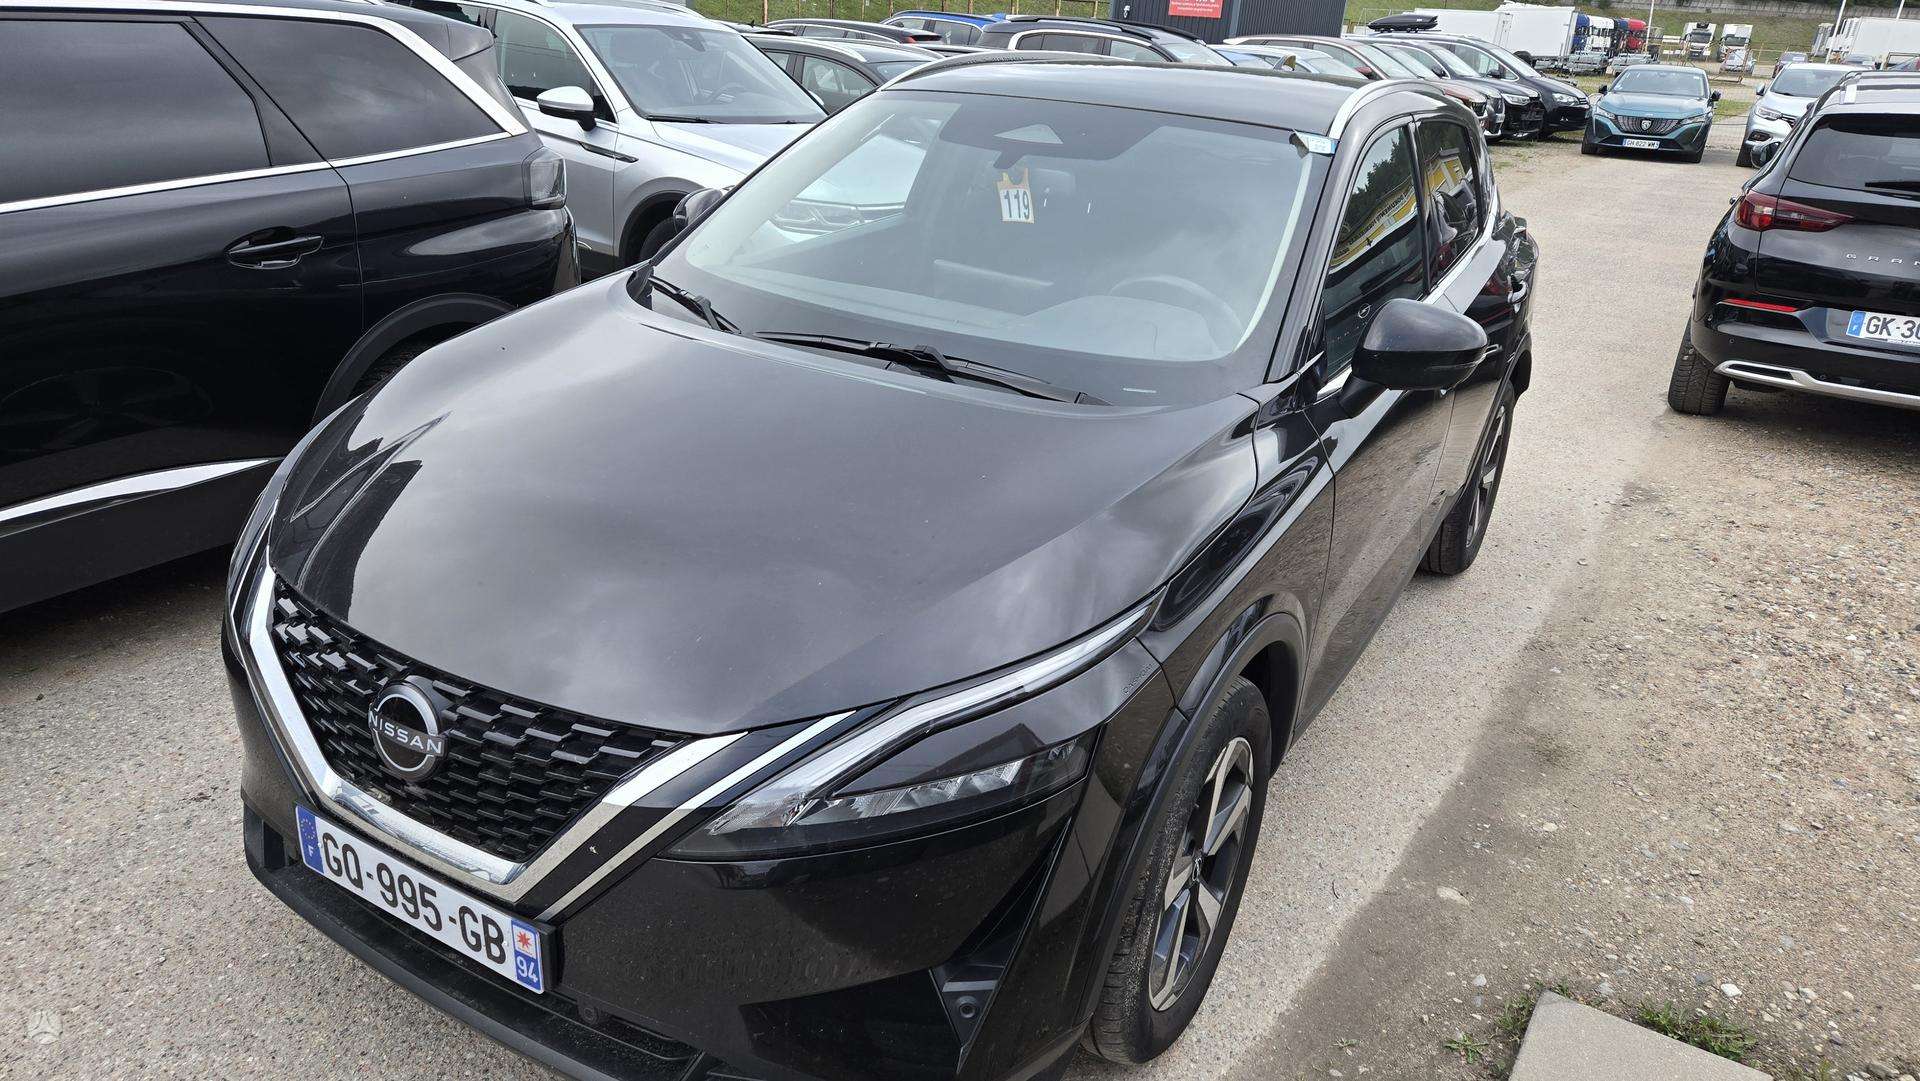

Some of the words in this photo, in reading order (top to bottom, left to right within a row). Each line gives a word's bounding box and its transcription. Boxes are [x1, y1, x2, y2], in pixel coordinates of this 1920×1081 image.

[1003, 190, 1030, 220] 119
[368, 710, 442, 753] NISSAN
[307, 845, 314, 857] F
[322, 832, 506, 965] GQ-995-GB
[516, 956, 538, 983] 94
